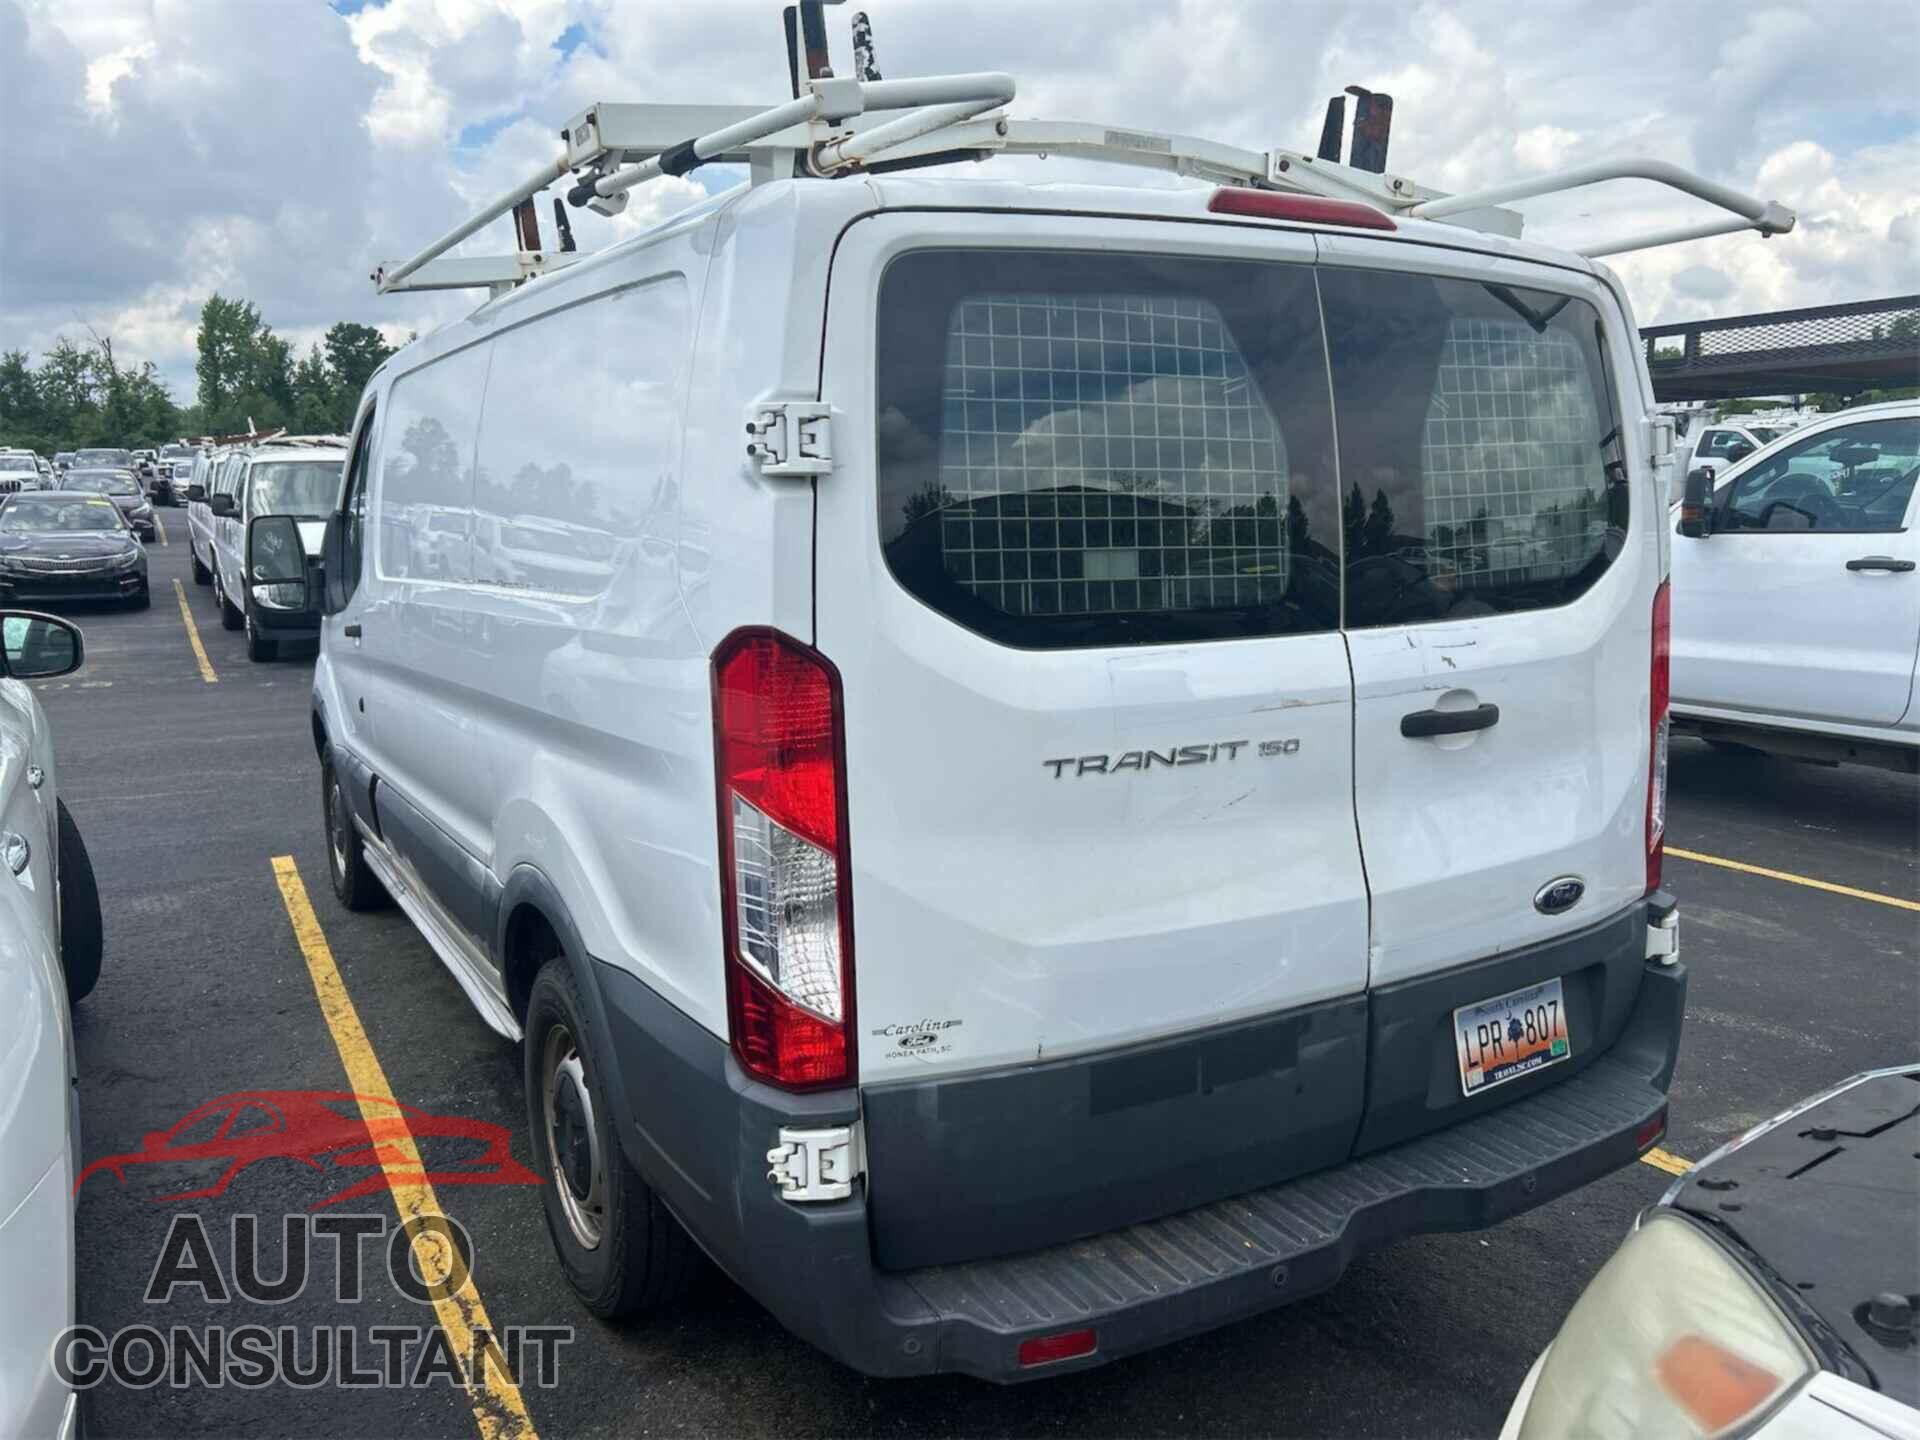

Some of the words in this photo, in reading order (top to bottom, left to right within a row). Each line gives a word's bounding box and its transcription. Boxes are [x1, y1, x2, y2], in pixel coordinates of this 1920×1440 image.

[1042, 740, 1250, 779] TRANSIT
[1258, 738, 1300, 757] 150
[883, 1018, 952, 1036] Carolina
[1464, 1020, 1505, 1069] LPR
[1524, 1000, 1559, 1045] 807
